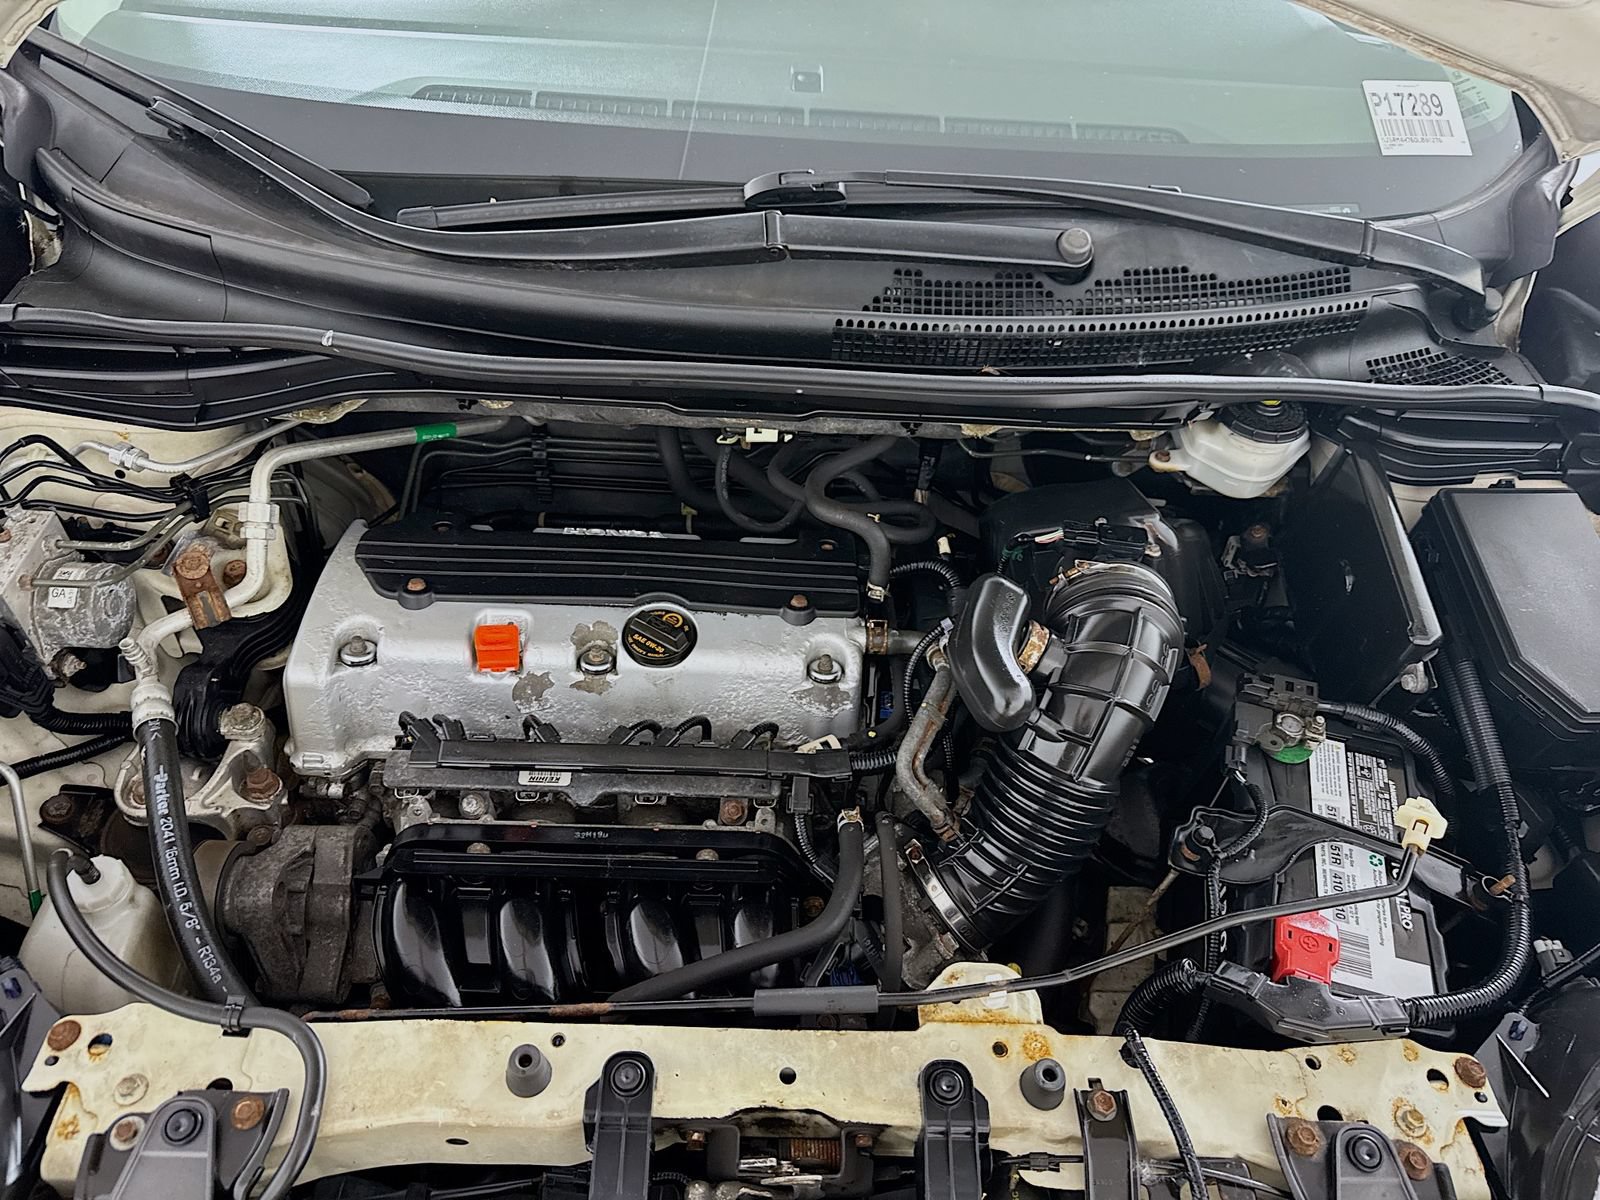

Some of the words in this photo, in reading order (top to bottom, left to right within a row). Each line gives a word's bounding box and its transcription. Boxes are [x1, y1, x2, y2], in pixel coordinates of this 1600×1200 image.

[1370, 93, 1443, 116] P17289
[51, 588, 66, 598] GA
[632, 634, 647, 644] SAE
[1330, 844, 1342, 866] 51R
[1332, 872, 1344, 893] 410
[165, 845, 180, 881] 16mm
[198, 946, 222, 984] R134a
[1335, 907, 1346, 920] 10
